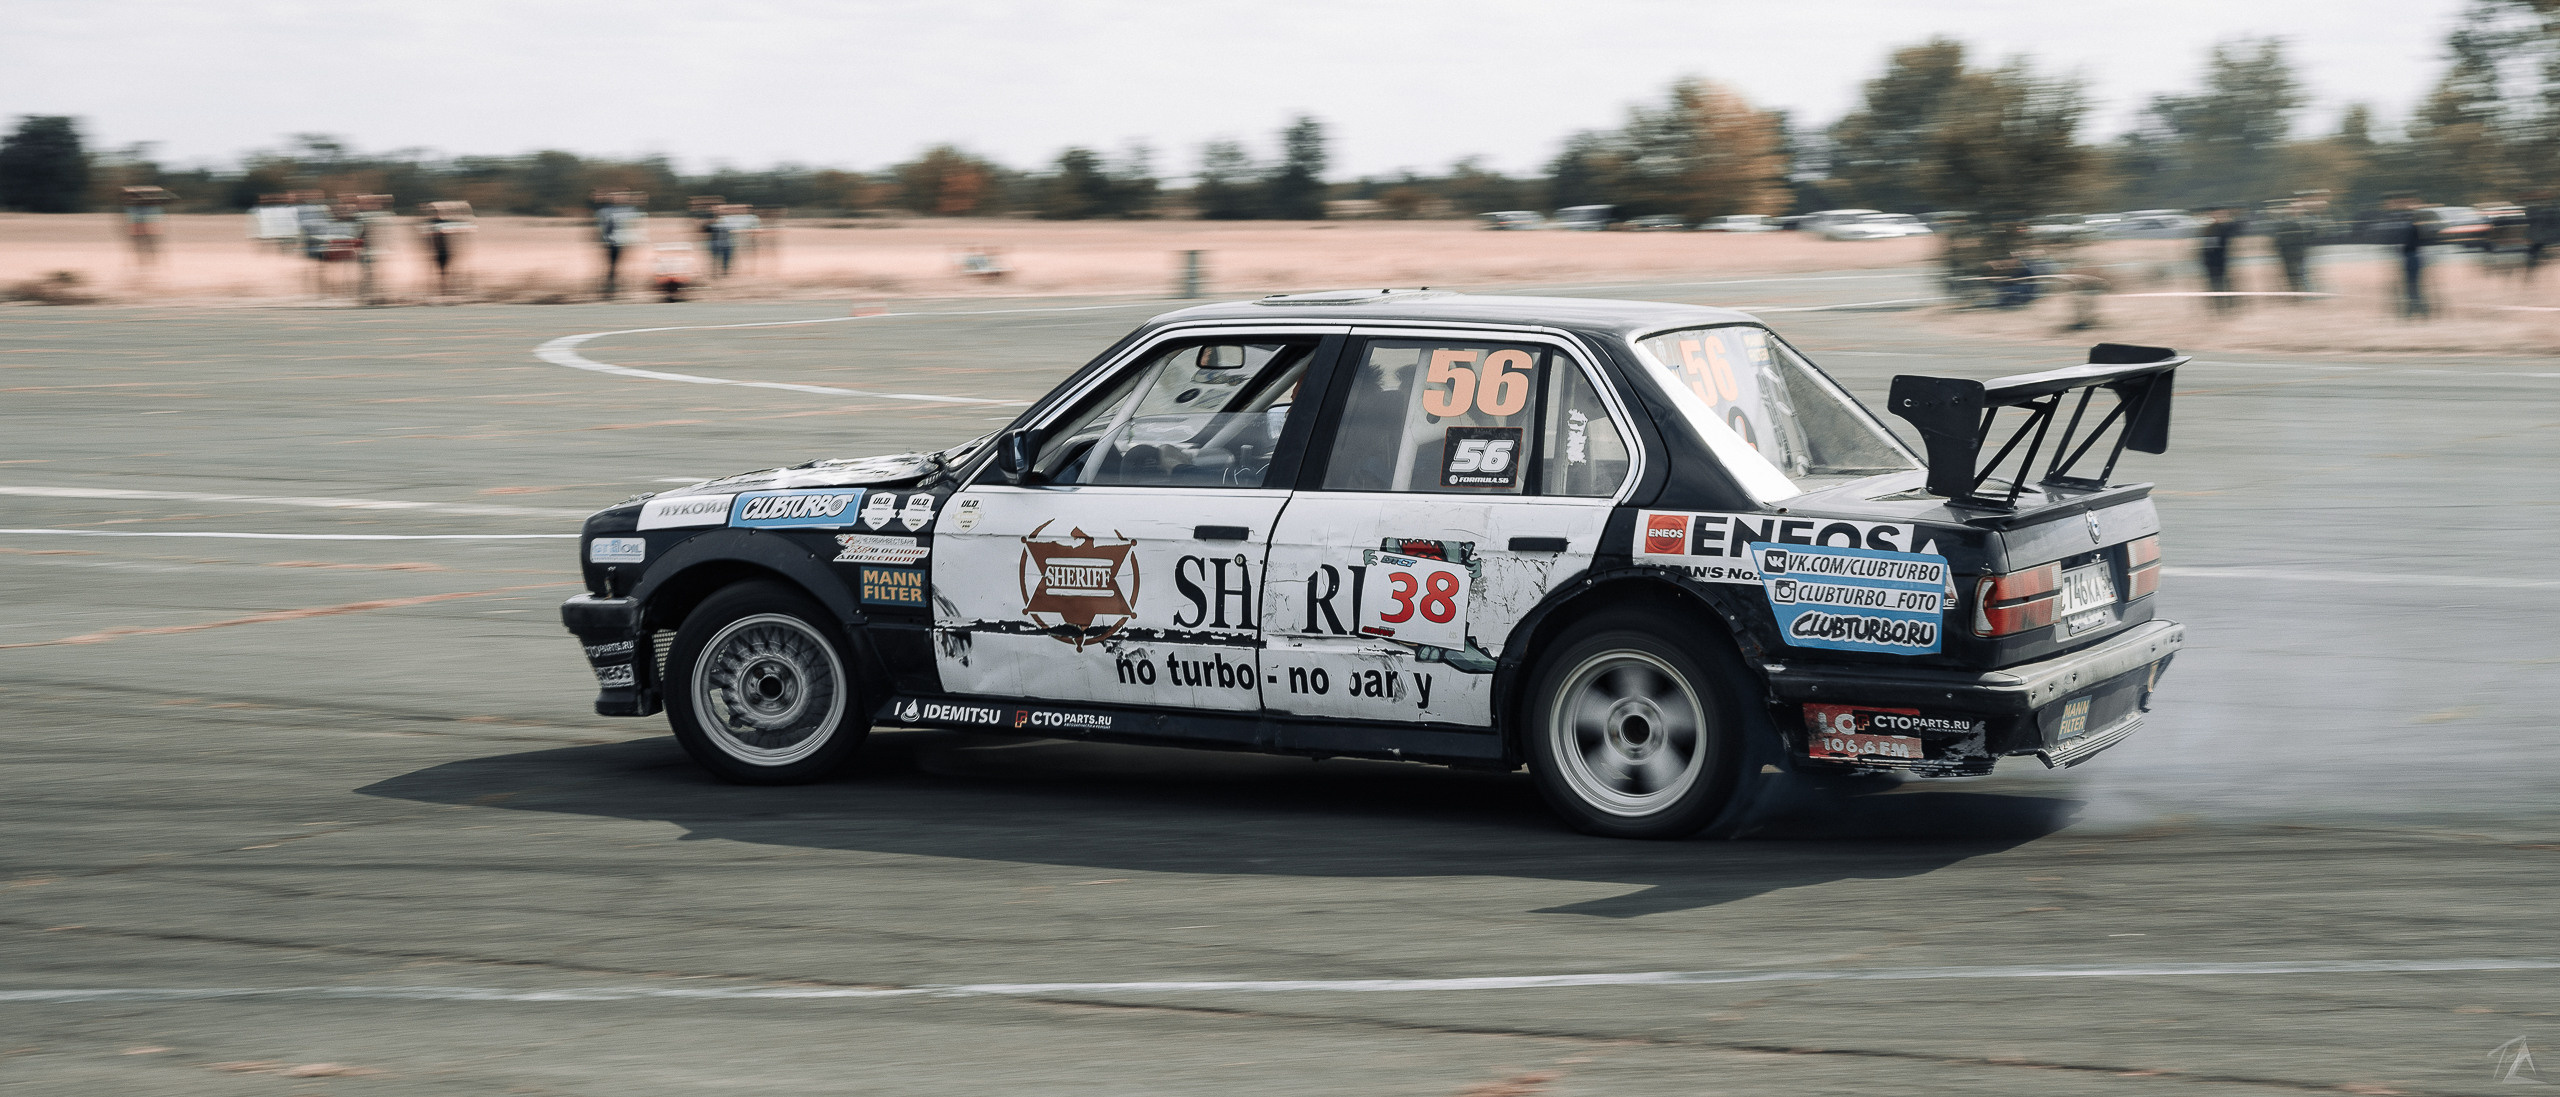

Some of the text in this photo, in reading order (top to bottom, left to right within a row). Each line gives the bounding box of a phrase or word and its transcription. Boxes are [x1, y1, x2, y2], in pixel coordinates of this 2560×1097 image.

[1422, 349, 1533, 417] 56
[1680, 335, 1738, 408] 56
[1448, 438, 1515, 473] 56
[741, 494, 855, 521] CLUBTURBO
[1648, 527, 1684, 539] ENEOS
[863, 570, 922, 587] MANN
[1044, 565, 1112, 588] SHERIFF
[1787, 554, 1940, 582] VK.COM/CLUBTURBO
[864, 585, 923, 602] FILTER
[1380, 570, 1460, 624] 38
[1798, 584, 1938, 611] CLUBTURBO_FOTO
[1791, 611, 1936, 646] CLUBTURBO.RU
[1115, 657, 1157, 685] no
[1166, 651, 1255, 690] turbo
[1289, 665, 1330, 696] no
[923, 703, 1001, 725] IDEMITSU
[2064, 700, 2090, 719] MANN
[1817, 712, 1856, 735] LO
[1874, 715, 1970, 730] CTOPARTS.RU
[2059, 716, 2086, 735] FILTER
[1822, 737, 1910, 758] 106.6 FM
